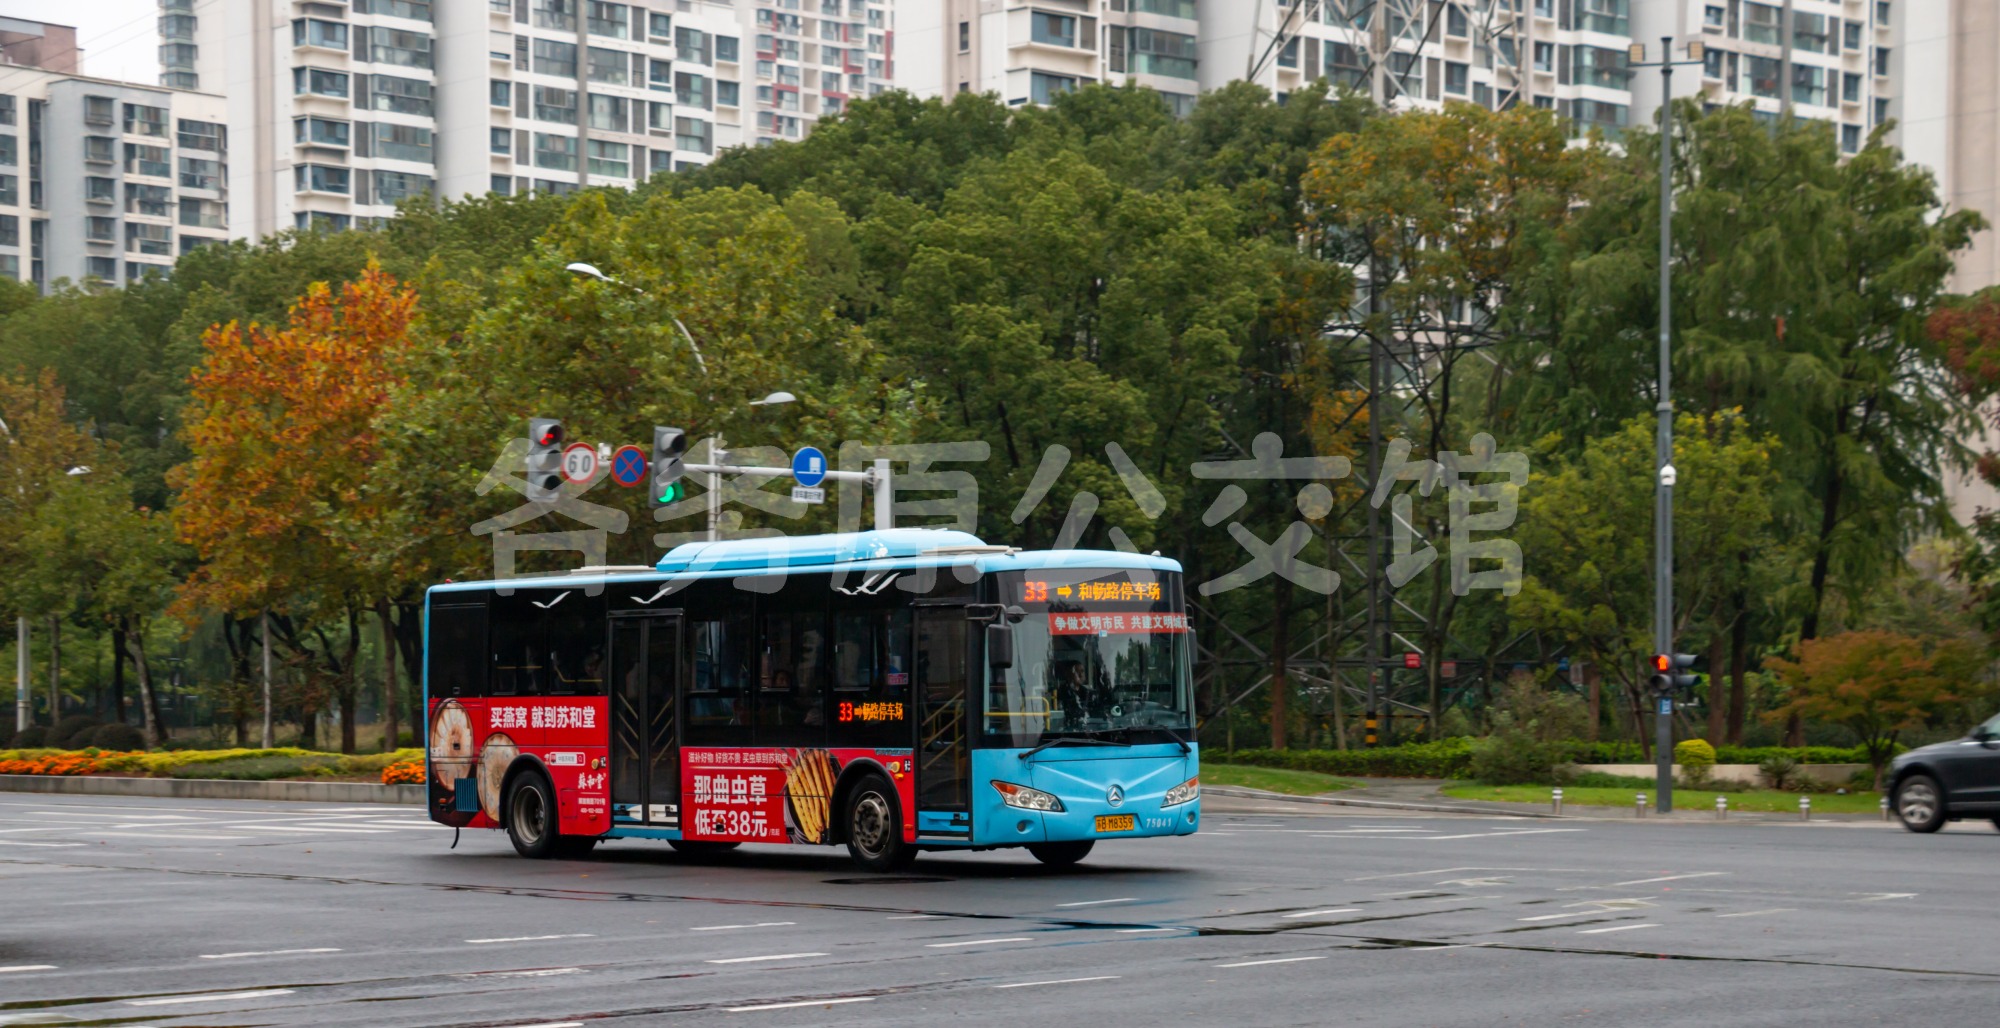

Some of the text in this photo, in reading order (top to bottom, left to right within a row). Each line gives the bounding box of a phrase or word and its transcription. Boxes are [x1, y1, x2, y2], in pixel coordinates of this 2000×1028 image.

[568, 454, 592, 474] 60
[1024, 581, 1161, 602] 33 和畅路停车场
[1055, 615, 1125, 631] 争做文明市民
[490, 706, 596, 729] 买燕窝 就到苏和堂
[839, 702, 853, 721] 33
[688, 752, 788, 764] 滋补好物 好货不贵 买虫草到苏和堂
[694, 774, 768, 805] 那曲虫草
[695, 808, 768, 837] 低至38元
